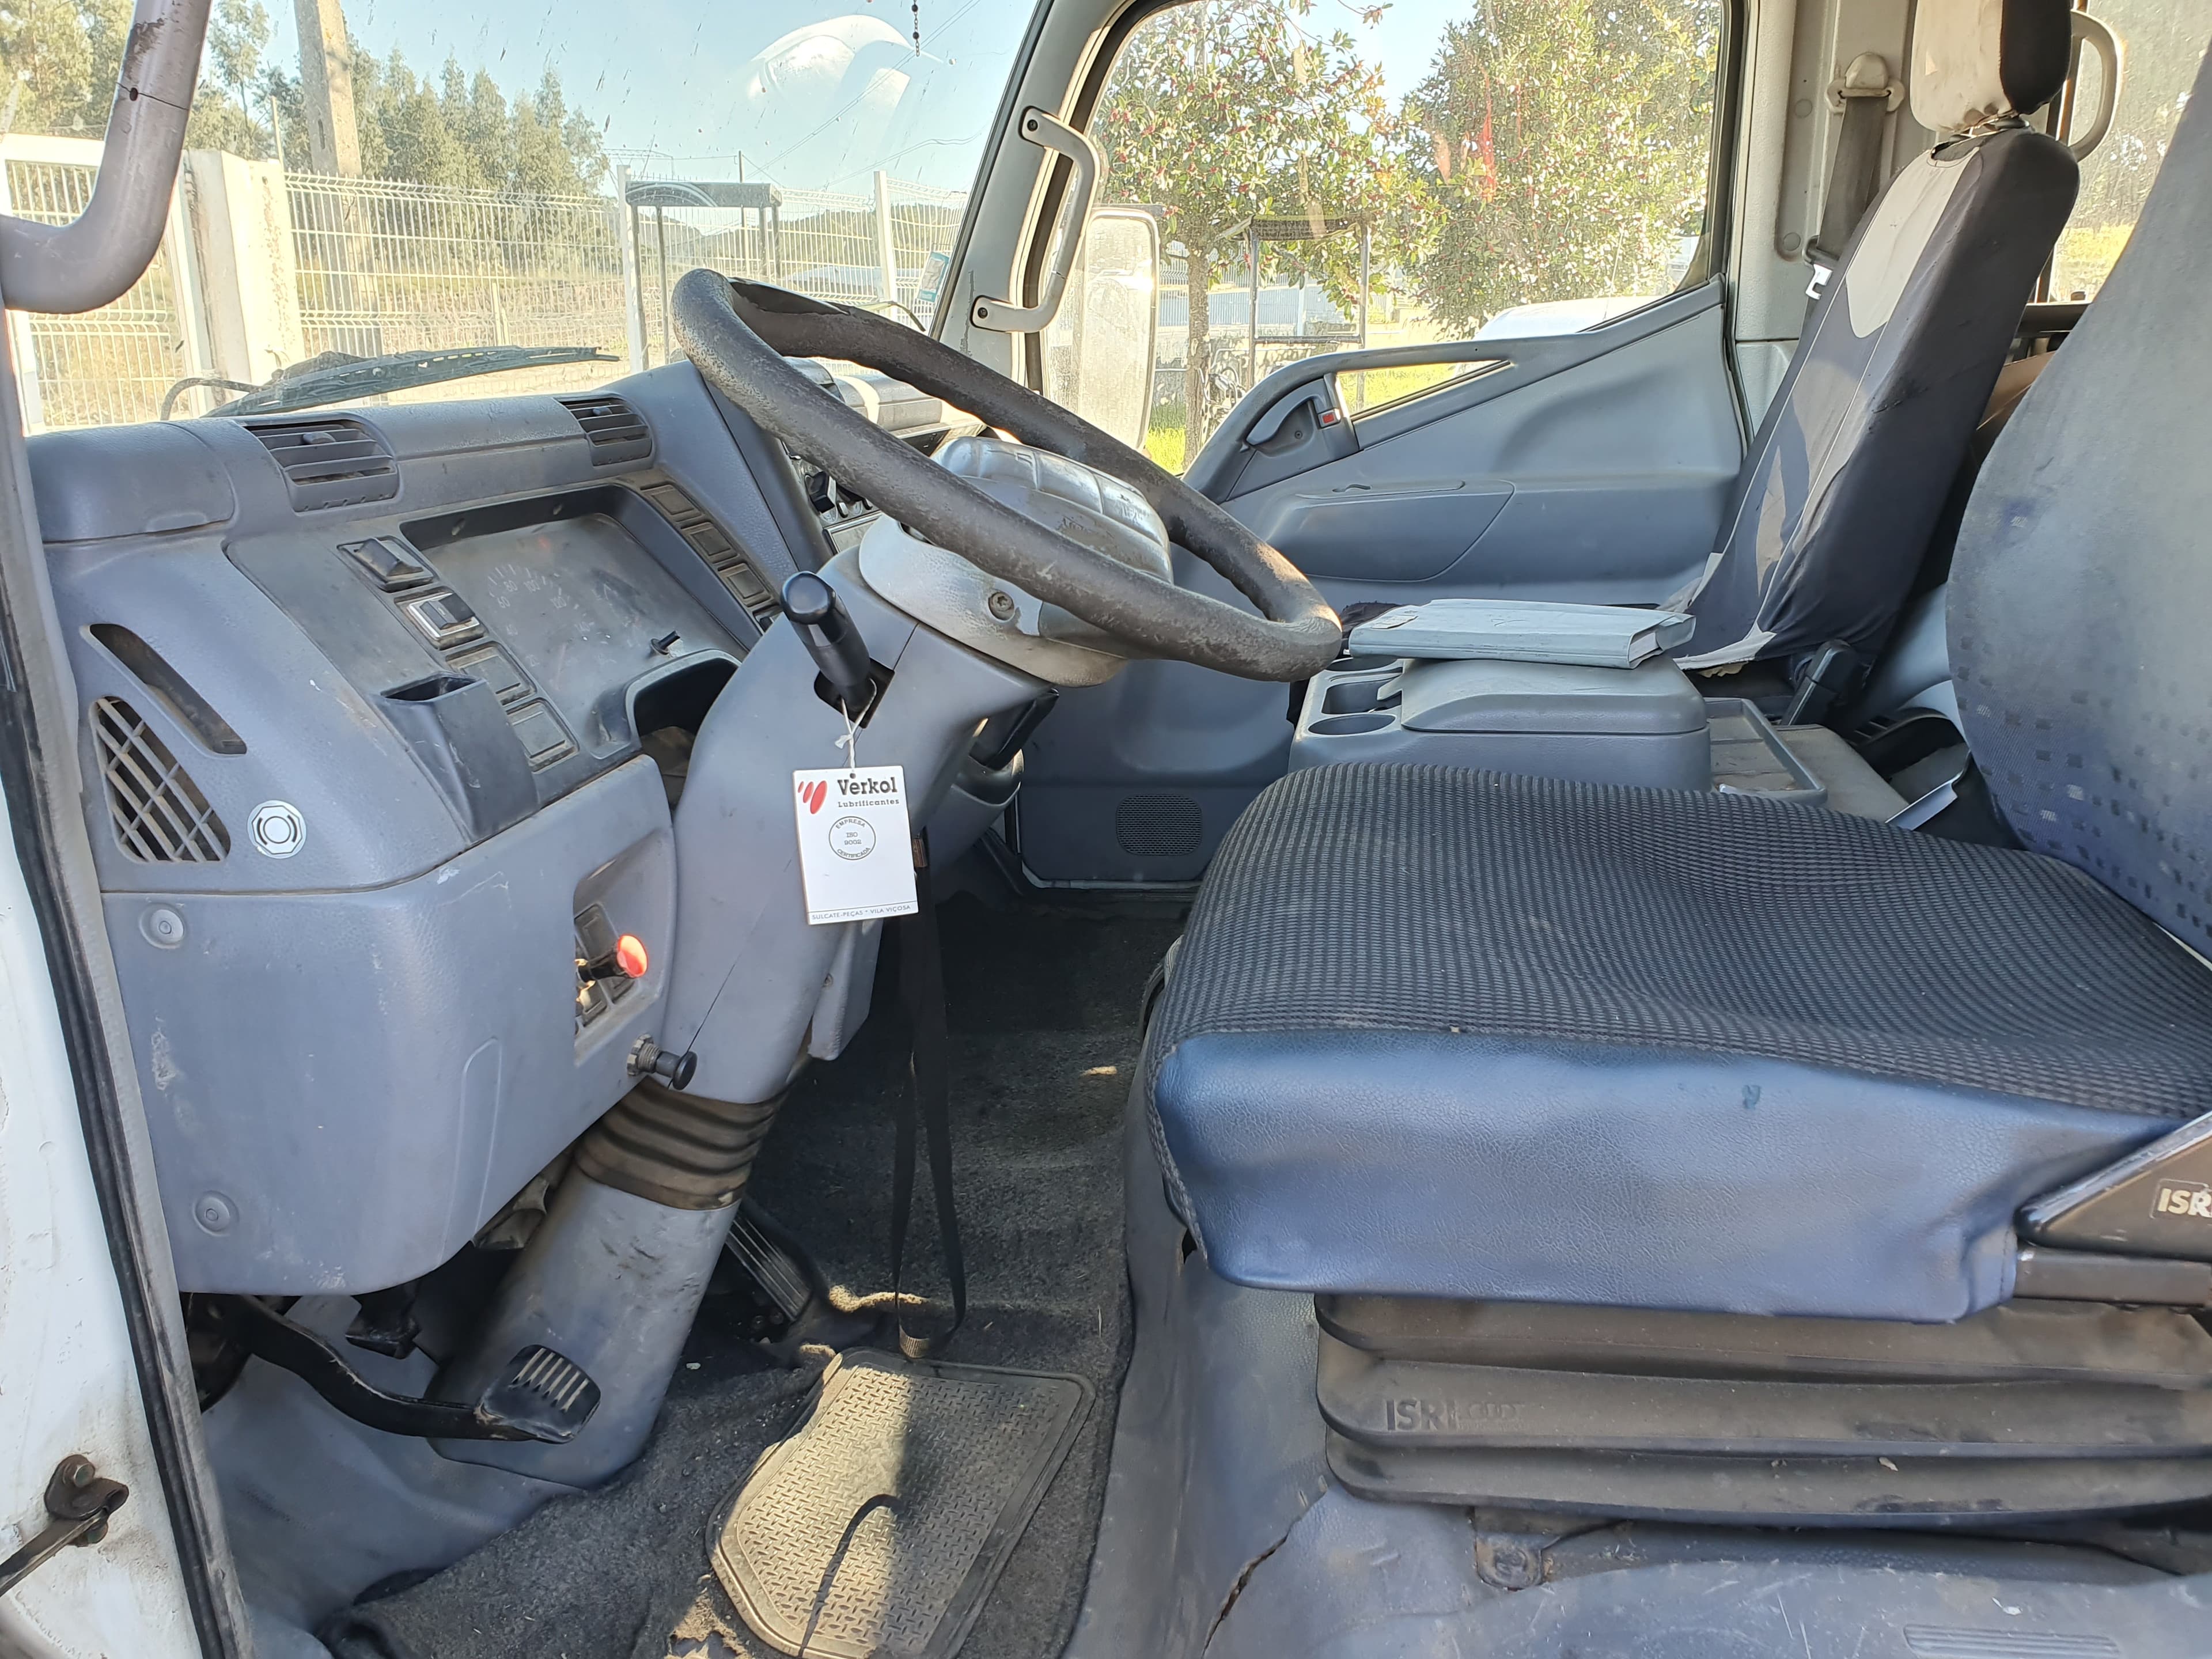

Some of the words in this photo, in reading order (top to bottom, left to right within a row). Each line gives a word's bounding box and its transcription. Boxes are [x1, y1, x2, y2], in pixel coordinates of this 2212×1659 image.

[837, 777, 898, 796] Verkol
[838, 798, 900, 808] Lubrificantes
[835, 819, 866, 830] EMPRESA
